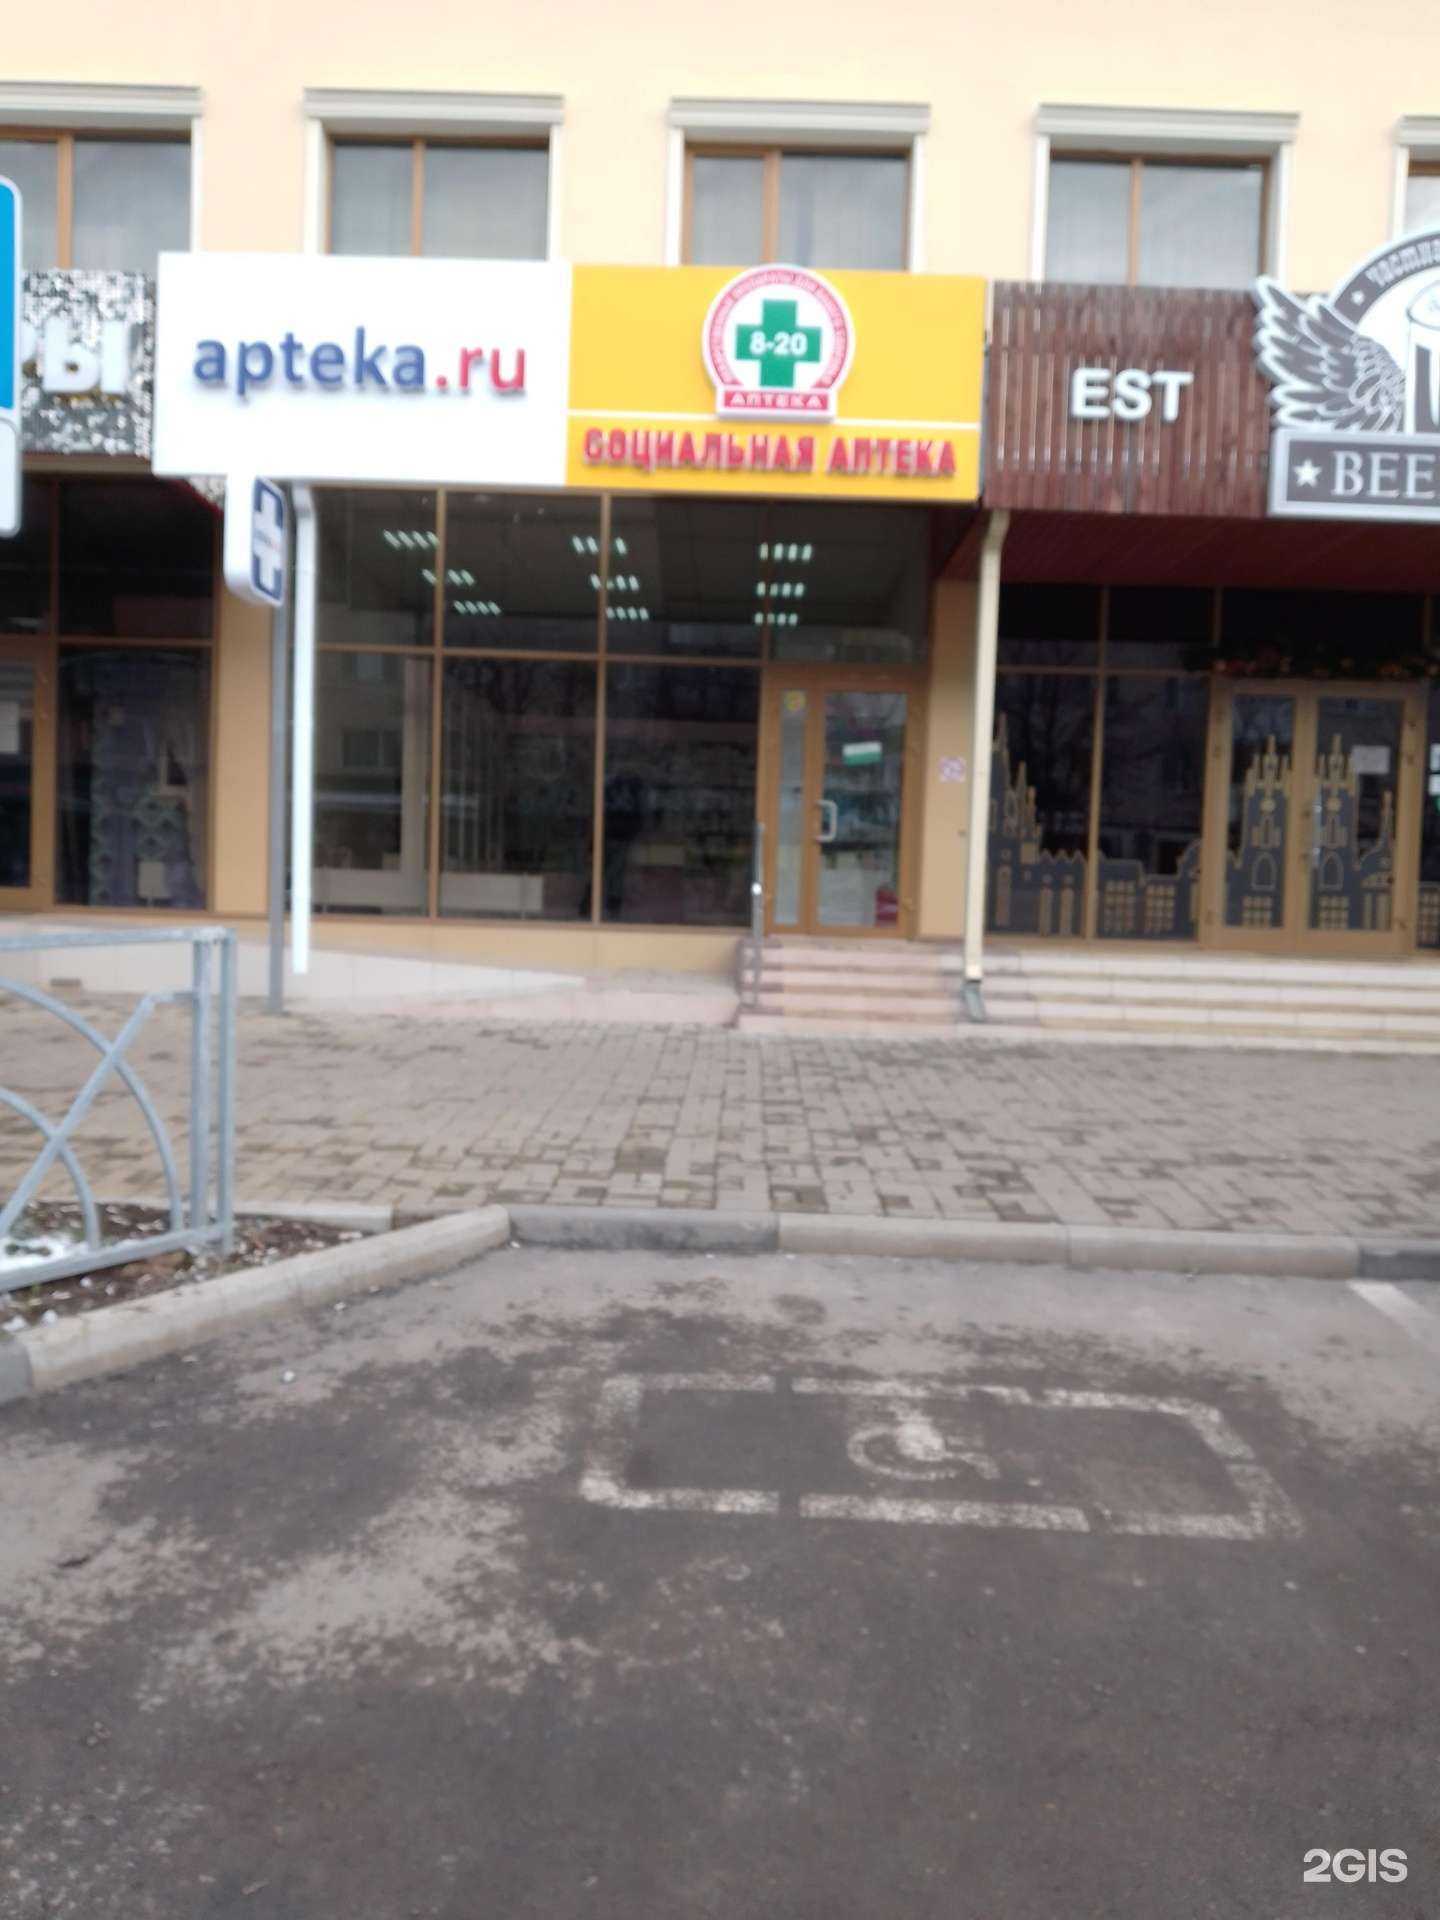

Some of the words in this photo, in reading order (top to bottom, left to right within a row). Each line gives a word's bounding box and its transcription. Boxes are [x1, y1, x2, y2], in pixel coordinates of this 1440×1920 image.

[193, 325, 525, 396] apteka.ru
[749, 330, 808, 357] 8-20
[730, 392, 823, 409] АПТЕКА
[1070, 367, 1194, 421] EST
[584, 428, 816, 472] СОЦИАЛЬНАЯ
[827, 437, 957, 477] АПТЕКА
